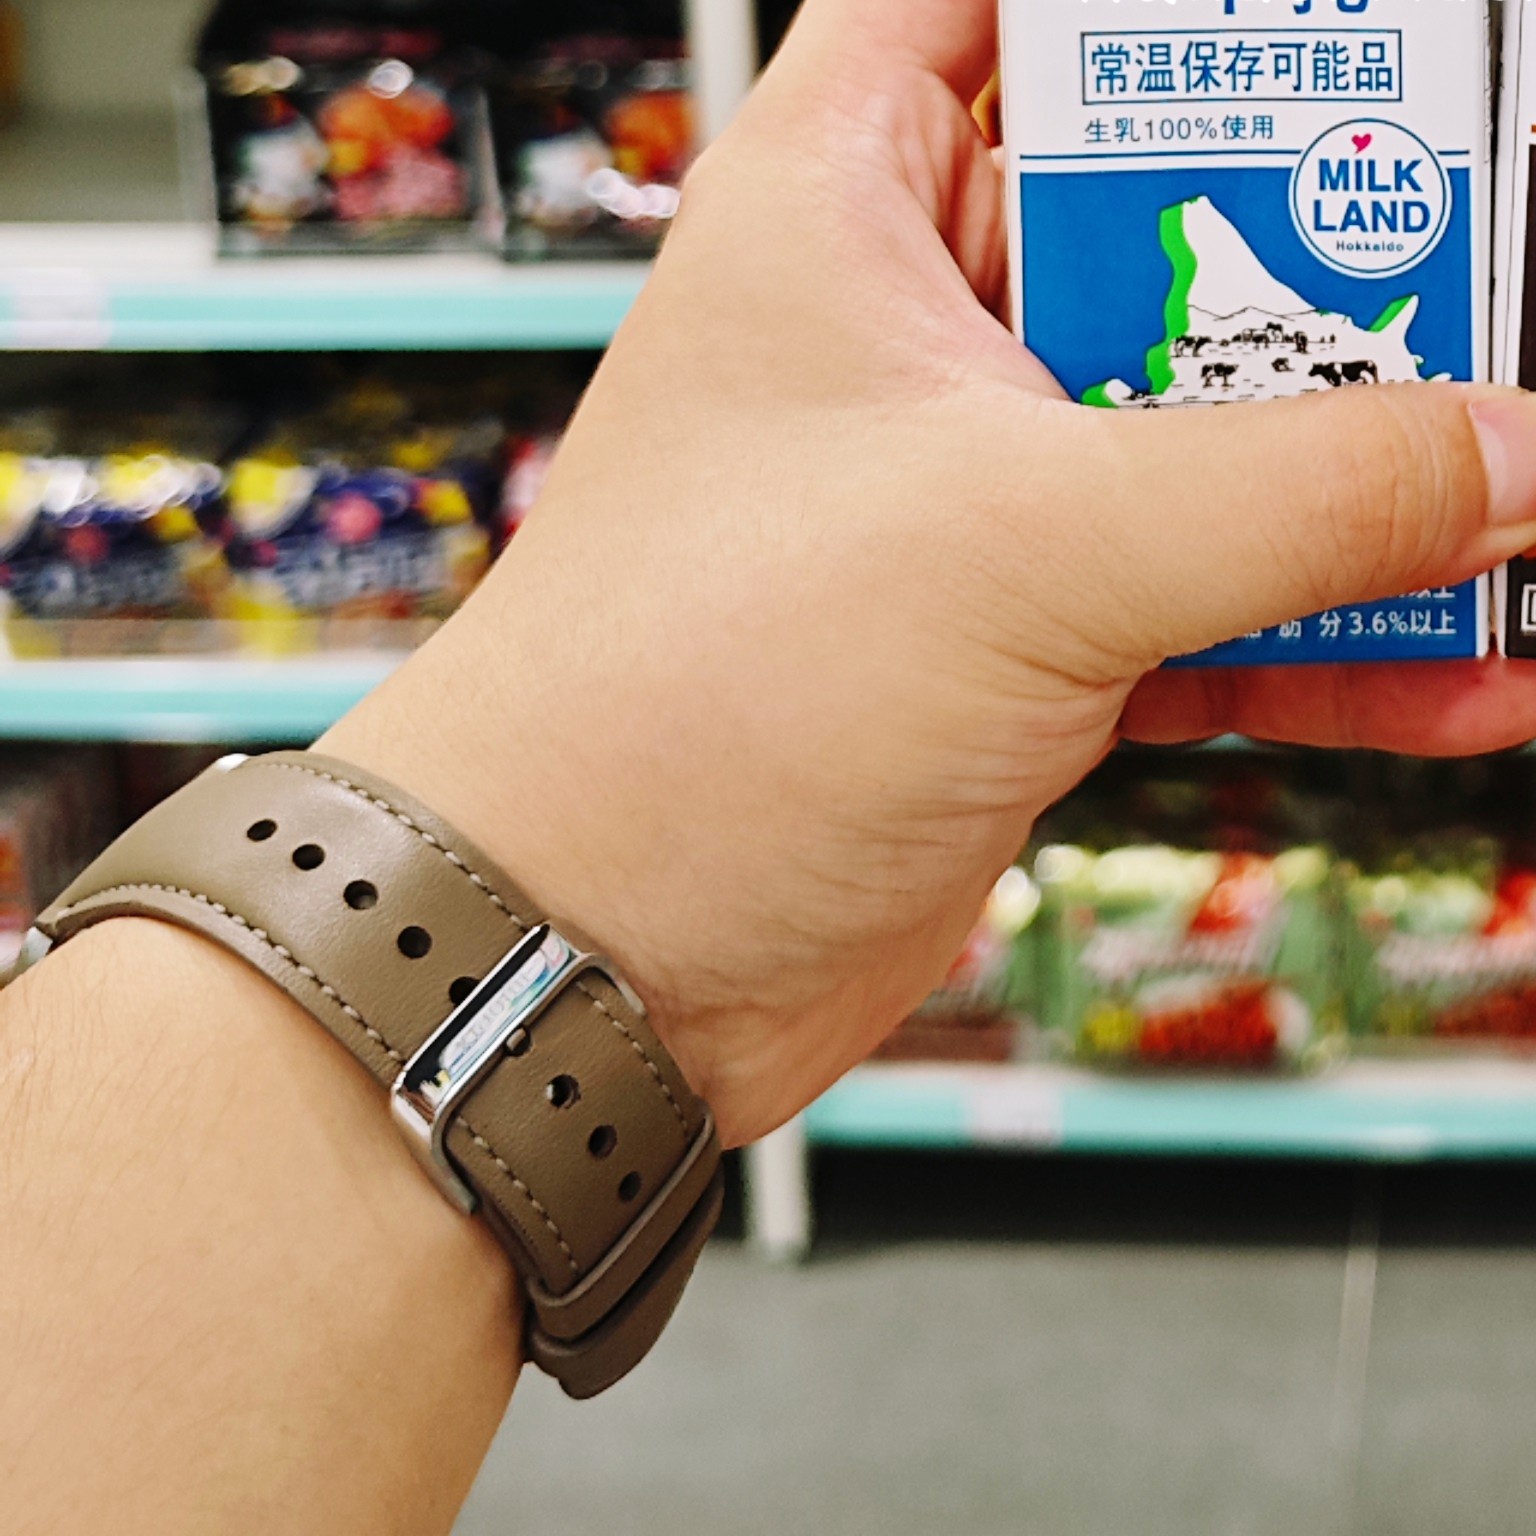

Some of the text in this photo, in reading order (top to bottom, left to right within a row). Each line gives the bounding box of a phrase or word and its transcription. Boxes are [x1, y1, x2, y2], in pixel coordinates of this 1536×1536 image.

[1090, 41, 1394, 95] 常温保存可能品
[1084, 114, 1275, 144] 生乳100%使用
[1318, 158, 1424, 193] MILK
[1312, 199, 1432, 235] LAND
[1335, 239, 1405, 253] Hokkaido
